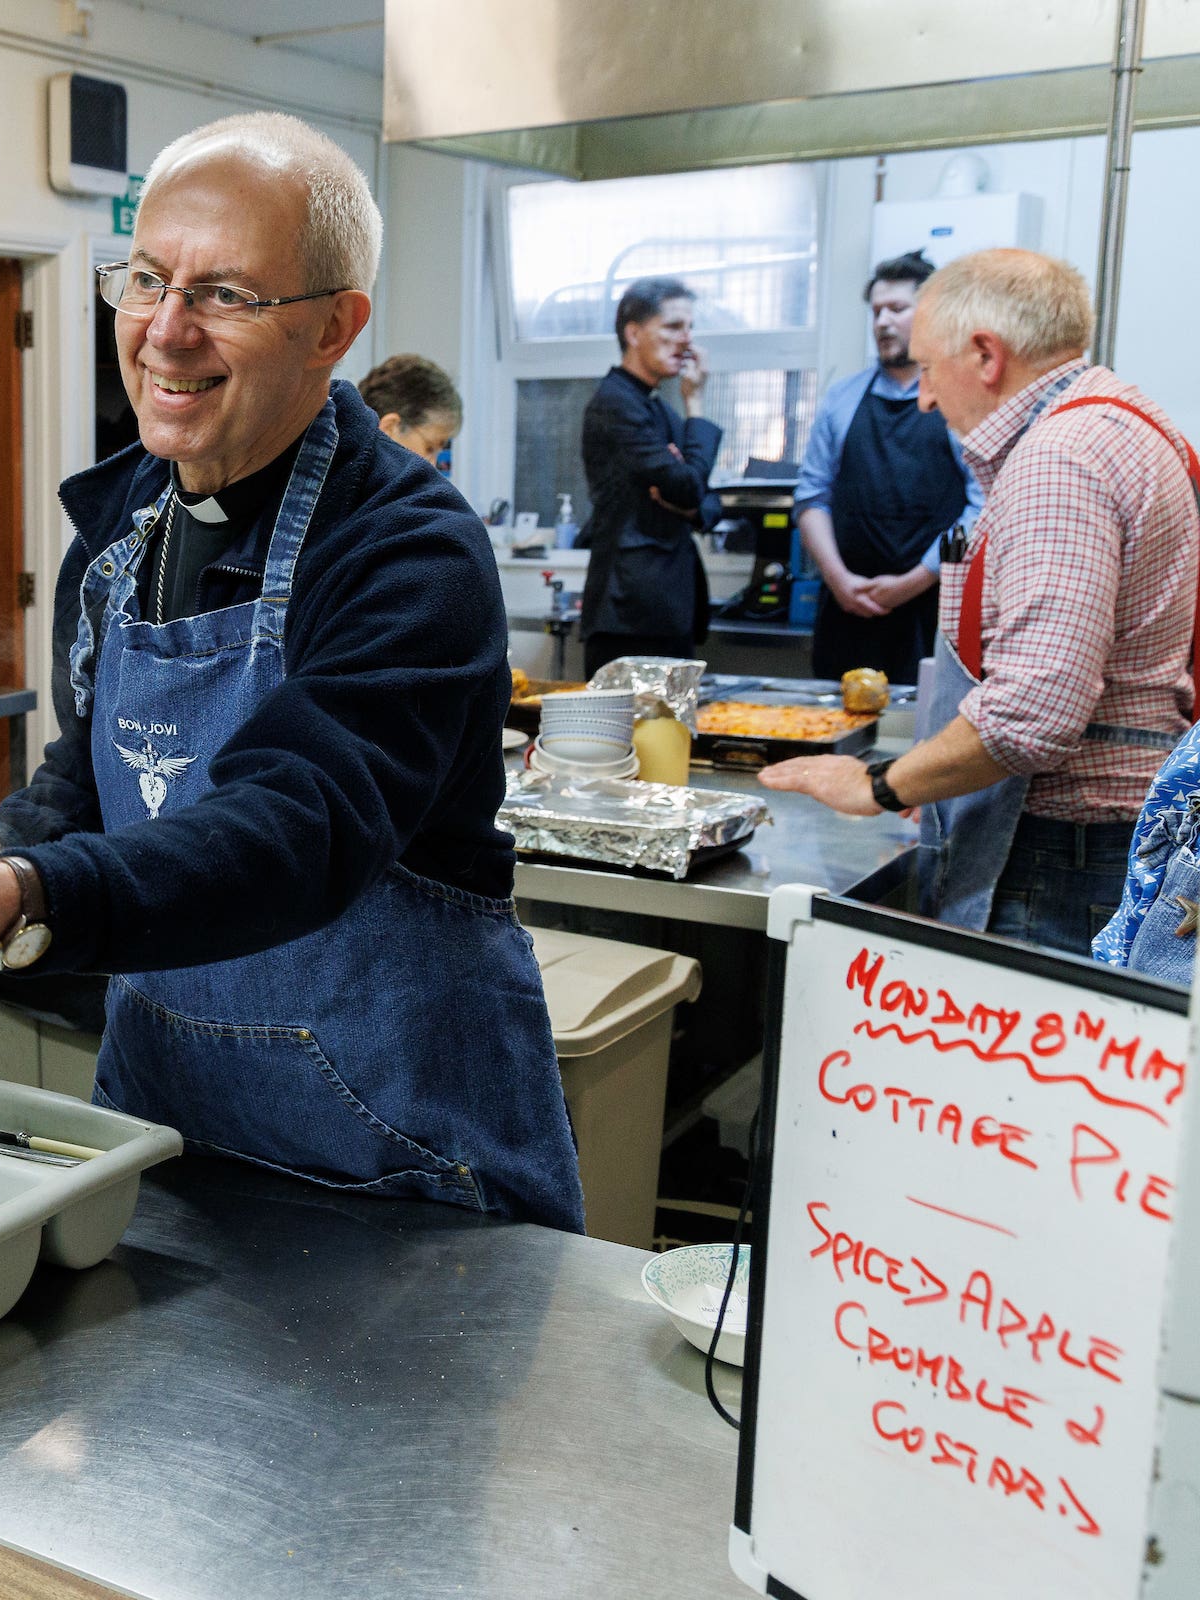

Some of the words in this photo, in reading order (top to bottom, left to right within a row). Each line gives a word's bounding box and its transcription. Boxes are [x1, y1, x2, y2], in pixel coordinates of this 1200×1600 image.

[845, 947, 1022, 1052] MONDAY
[818, 1049, 1038, 1170] COTTAGE
[1069, 1122, 1176, 1222] PIE
[806, 1201, 949, 1306] SPICED
[959, 1269, 1125, 1384] APPLE
